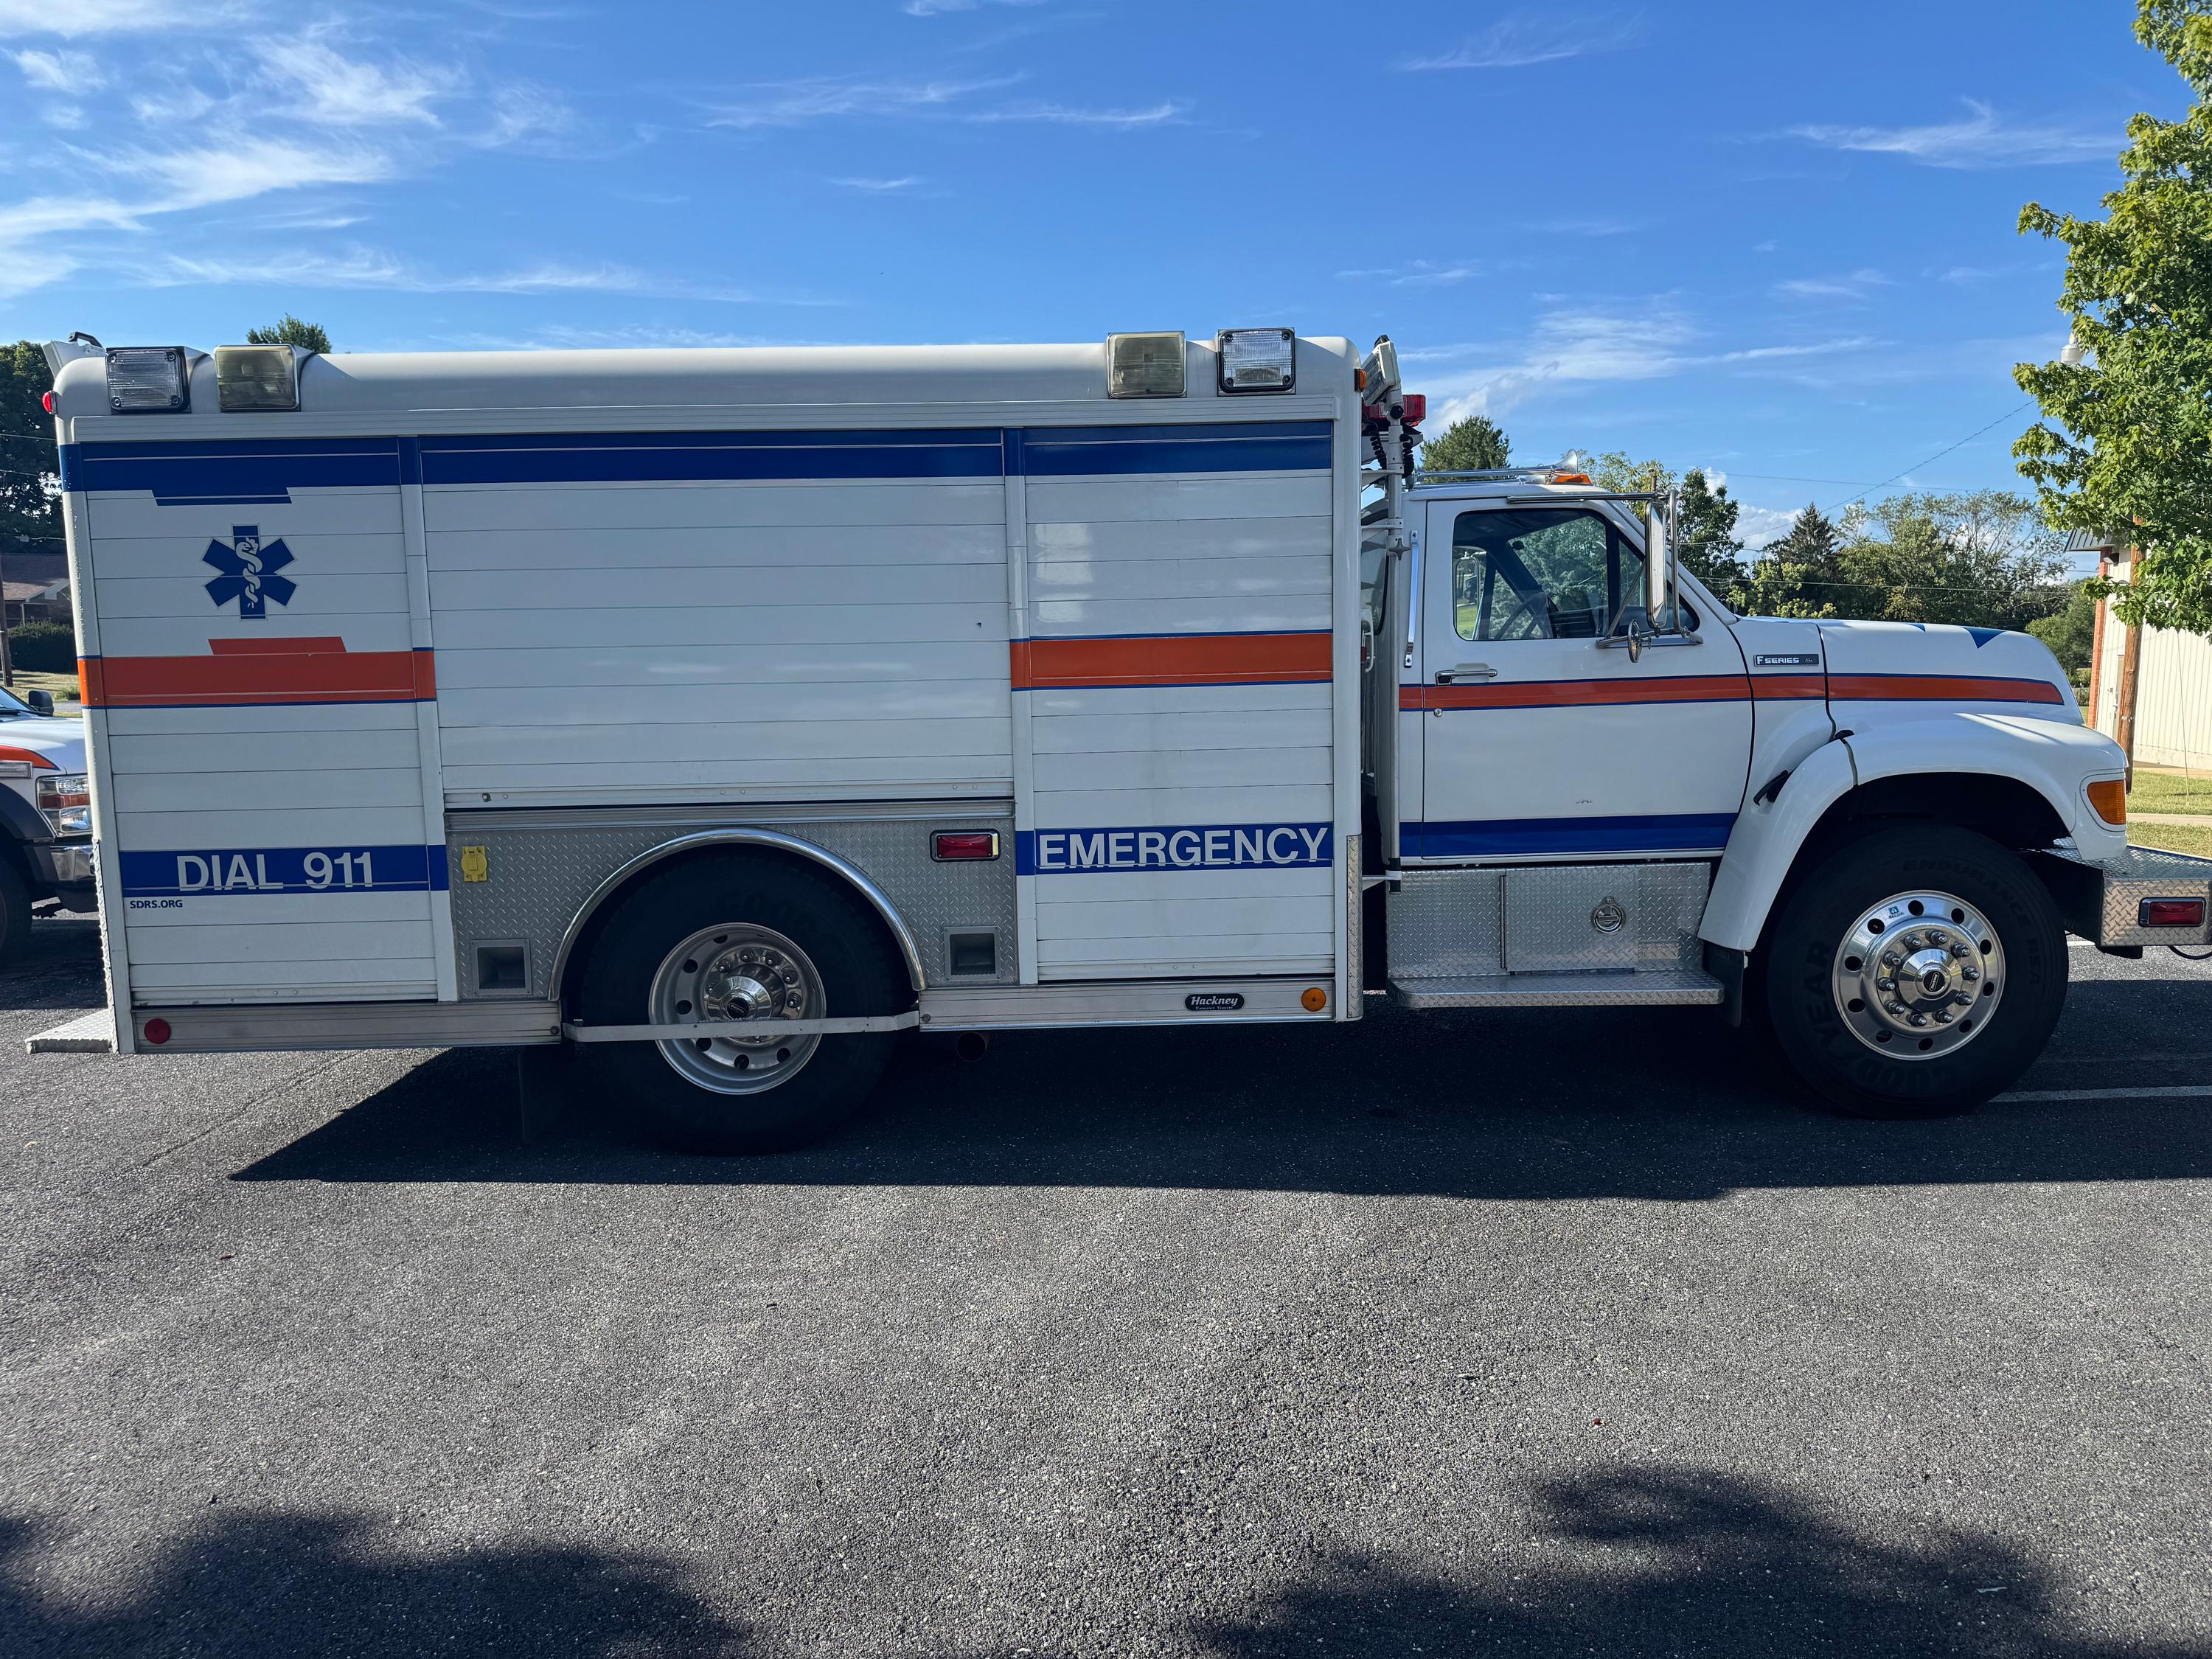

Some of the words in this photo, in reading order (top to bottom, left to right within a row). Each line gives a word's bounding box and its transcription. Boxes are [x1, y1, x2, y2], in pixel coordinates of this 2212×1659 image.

[1756, 655, 1764, 664] F
[1039, 827, 1328, 869] EMERGENCY
[176, 853, 284, 891] DIAL
[303, 851, 373, 889] 911
[129, 899, 184, 909] SDRS.ORG
[1191, 995, 1239, 1006] Hackney
